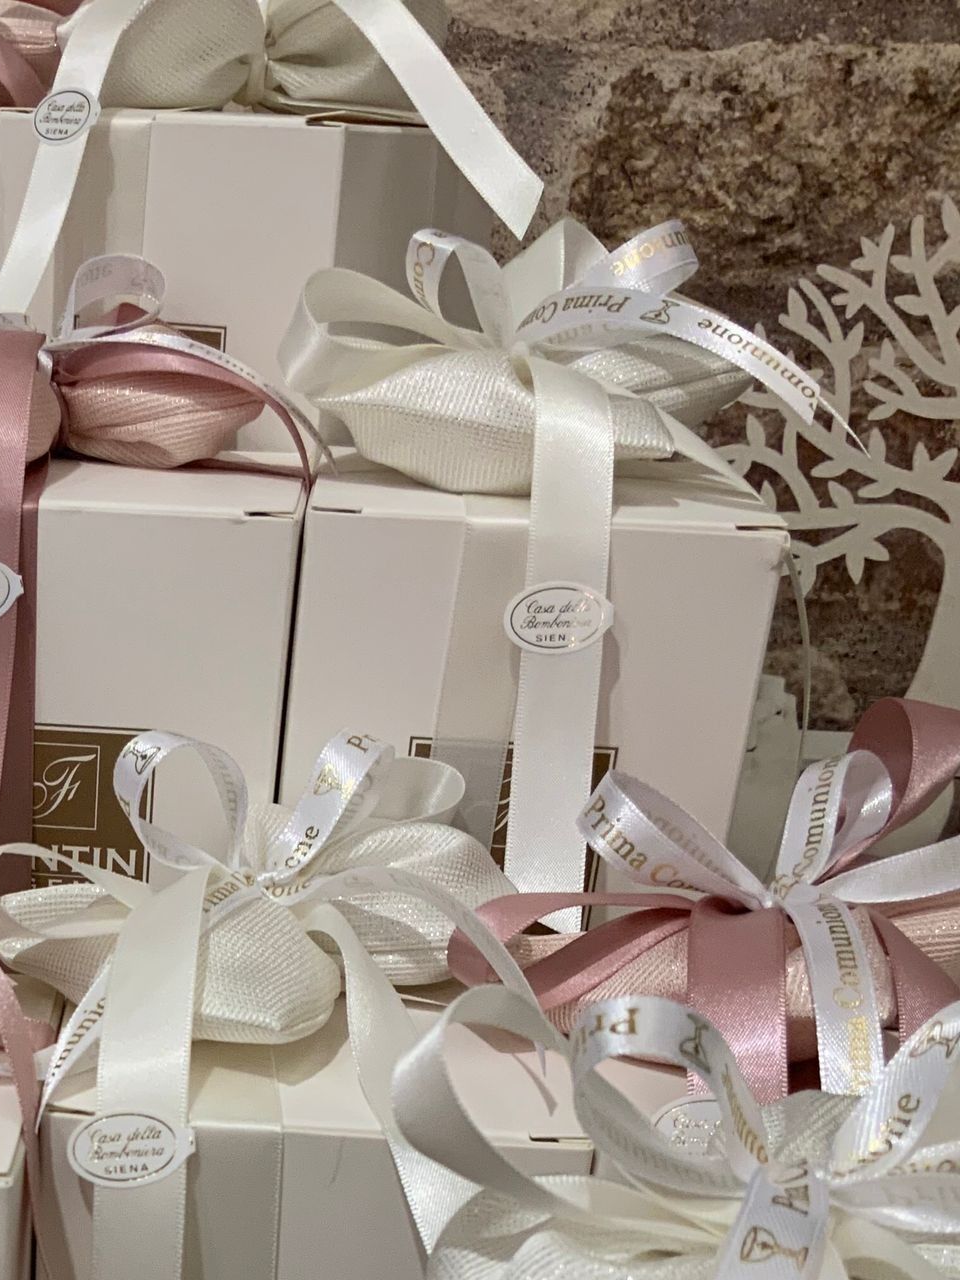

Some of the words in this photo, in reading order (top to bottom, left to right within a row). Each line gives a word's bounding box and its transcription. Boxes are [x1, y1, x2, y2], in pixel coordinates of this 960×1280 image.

[560, 294, 632, 314] Prima
[526, 599, 555, 614] Casa
[582, 794, 650, 872] Prima
[88, 1128, 123, 1144] Casa
[103, 1163, 150, 1175] SIENA
